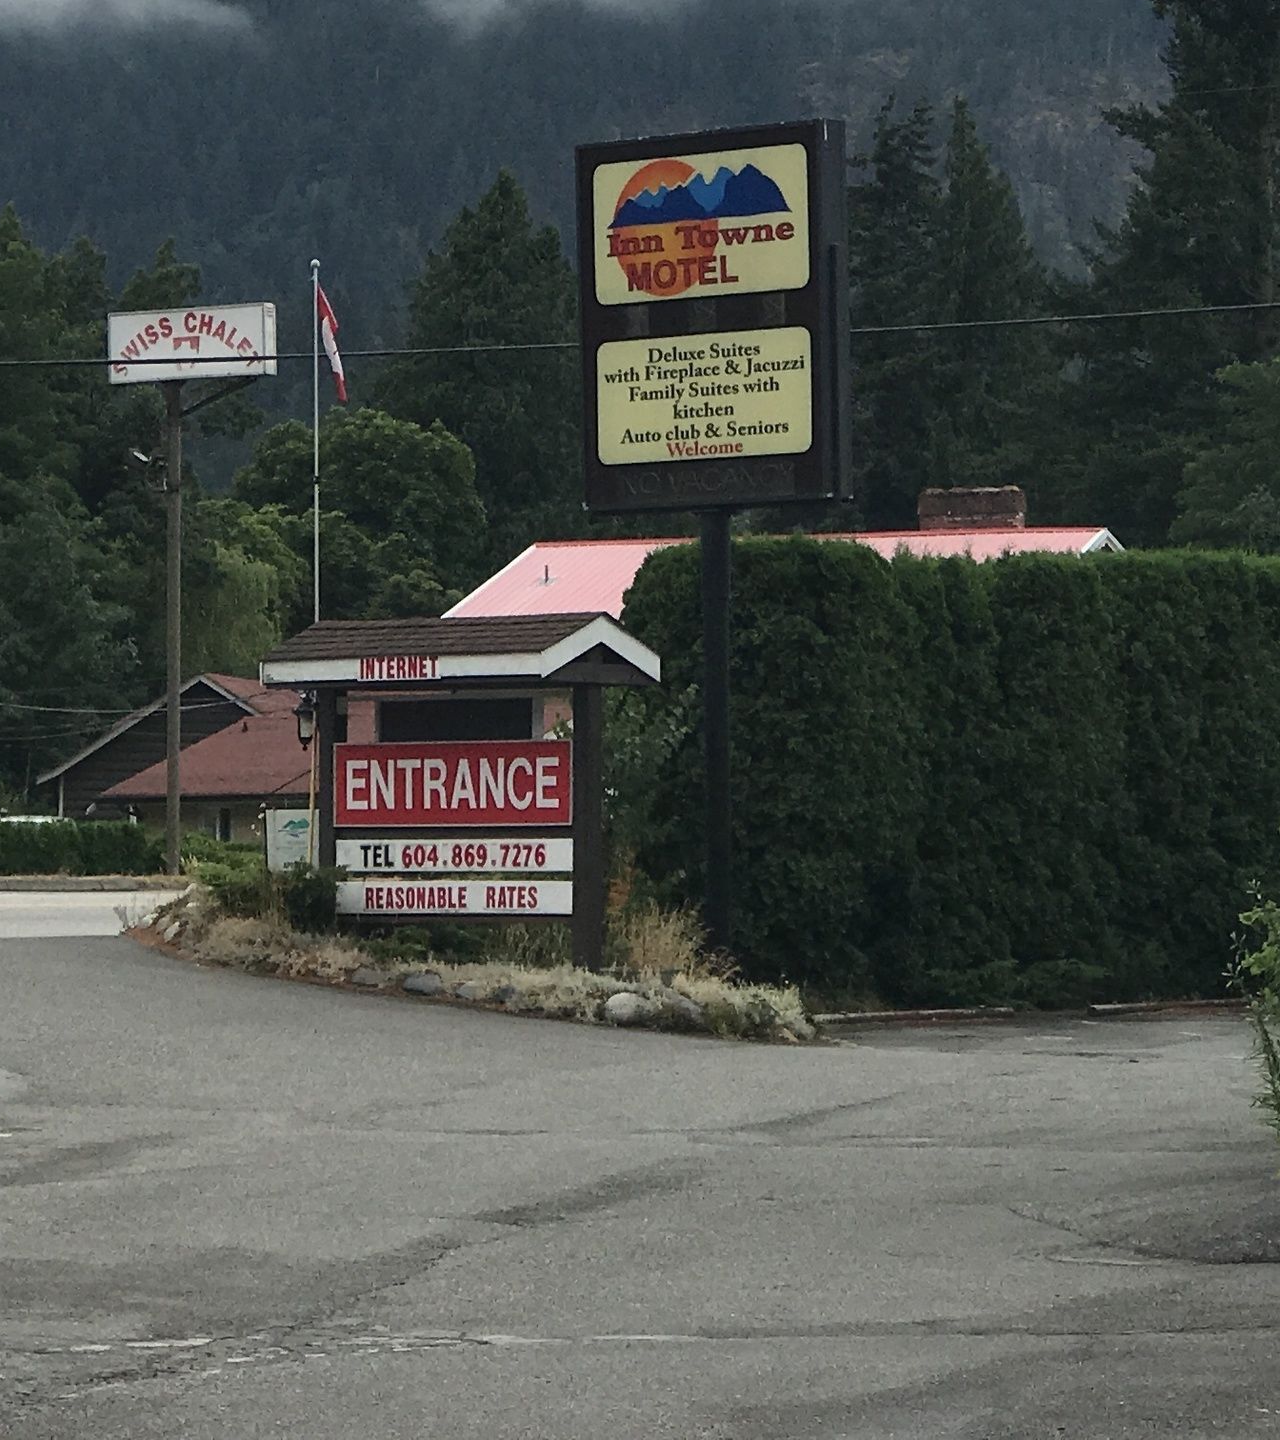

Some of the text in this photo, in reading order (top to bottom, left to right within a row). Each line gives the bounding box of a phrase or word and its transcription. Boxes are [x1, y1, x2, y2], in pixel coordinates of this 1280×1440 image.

[606, 221, 795, 258] Inn Towne
[627, 255, 739, 292] MOTEL
[112, 316, 173, 377] SWISS
[648, 342, 761, 364] Deluxe Suites
[604, 355, 805, 384] with Fireplace & Jacuzzi
[628, 376, 780, 404] Family Suites with
[672, 401, 735, 420] kitchen
[620, 420, 790, 445] Auto club & Seniors
[666, 440, 744, 458] Welcome
[359, 656, 439, 680] INTERNET
[345, 756, 561, 811] ENTRANCE
[360, 843, 547, 869] TEL 604.869.7276
[365, 885, 539, 910] REASONABLE RATES
